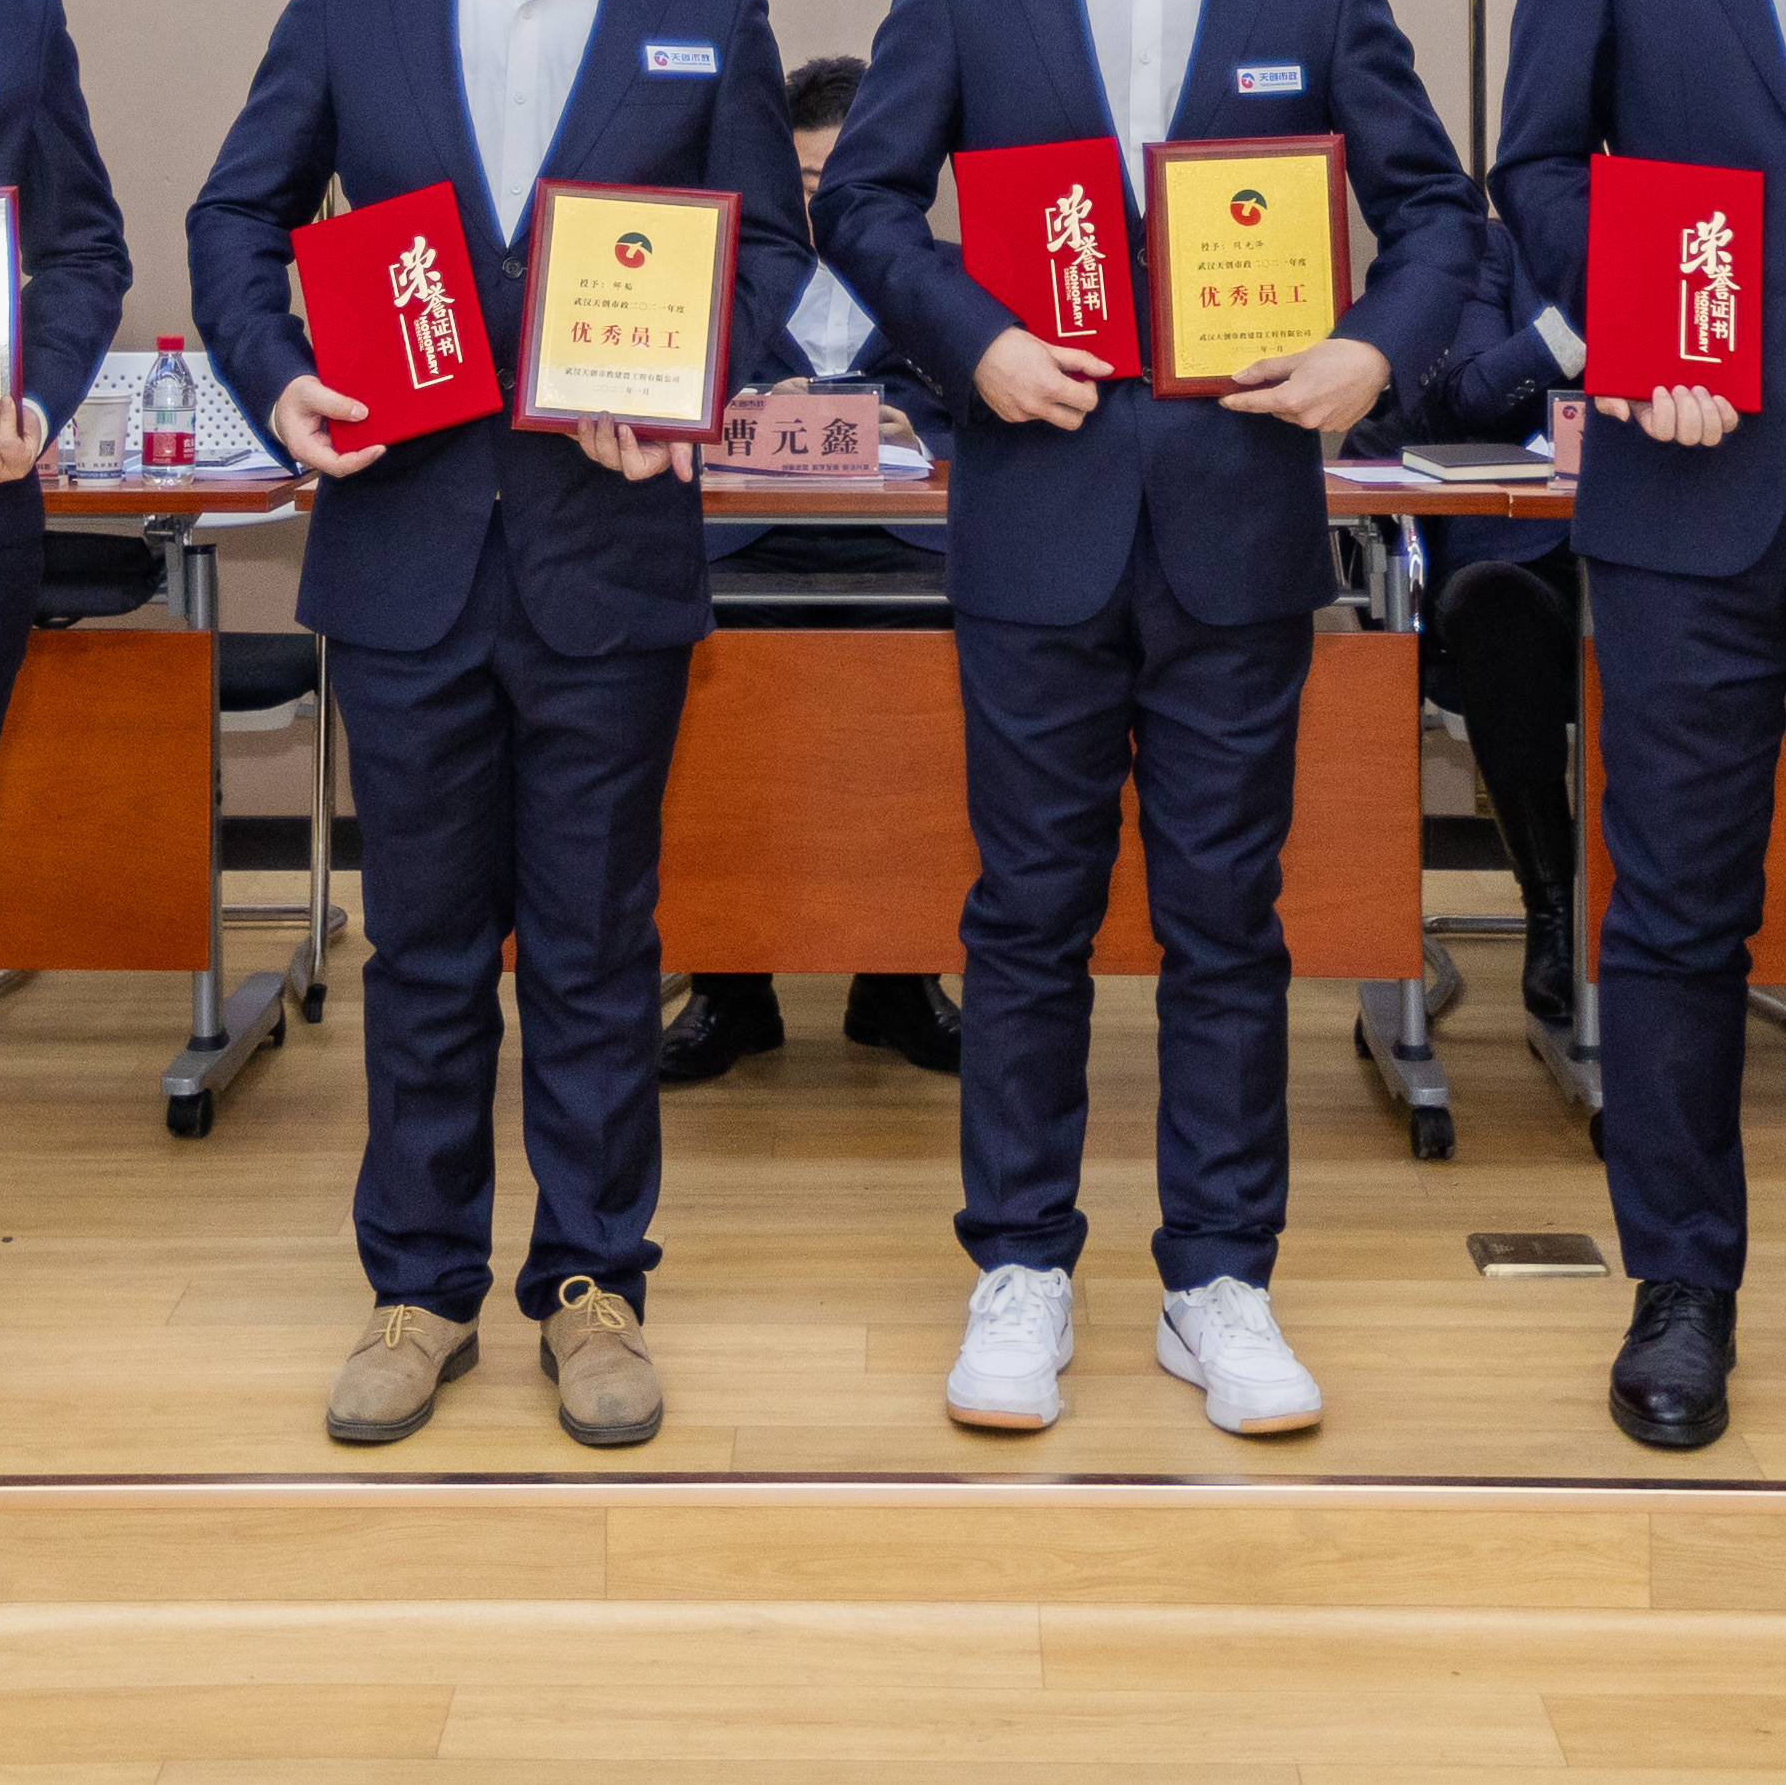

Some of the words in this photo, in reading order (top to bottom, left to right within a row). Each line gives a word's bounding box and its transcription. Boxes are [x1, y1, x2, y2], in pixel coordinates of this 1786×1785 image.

[1047, 184, 1106, 311] 荣誉证书
[1680, 211, 1741, 339] 荣誉证书
[394, 236, 455, 357] 荣誉证书
[1069, 265, 1083, 328] HONORARY
[1199, 283, 1308, 309] 优秀员工
[1698, 290, 1710, 353] HONORARY
[419, 315, 439, 375] HONORARY
[570, 321, 681, 349] 优秀员工
[724, 417, 859, 456] 曹元鑫
